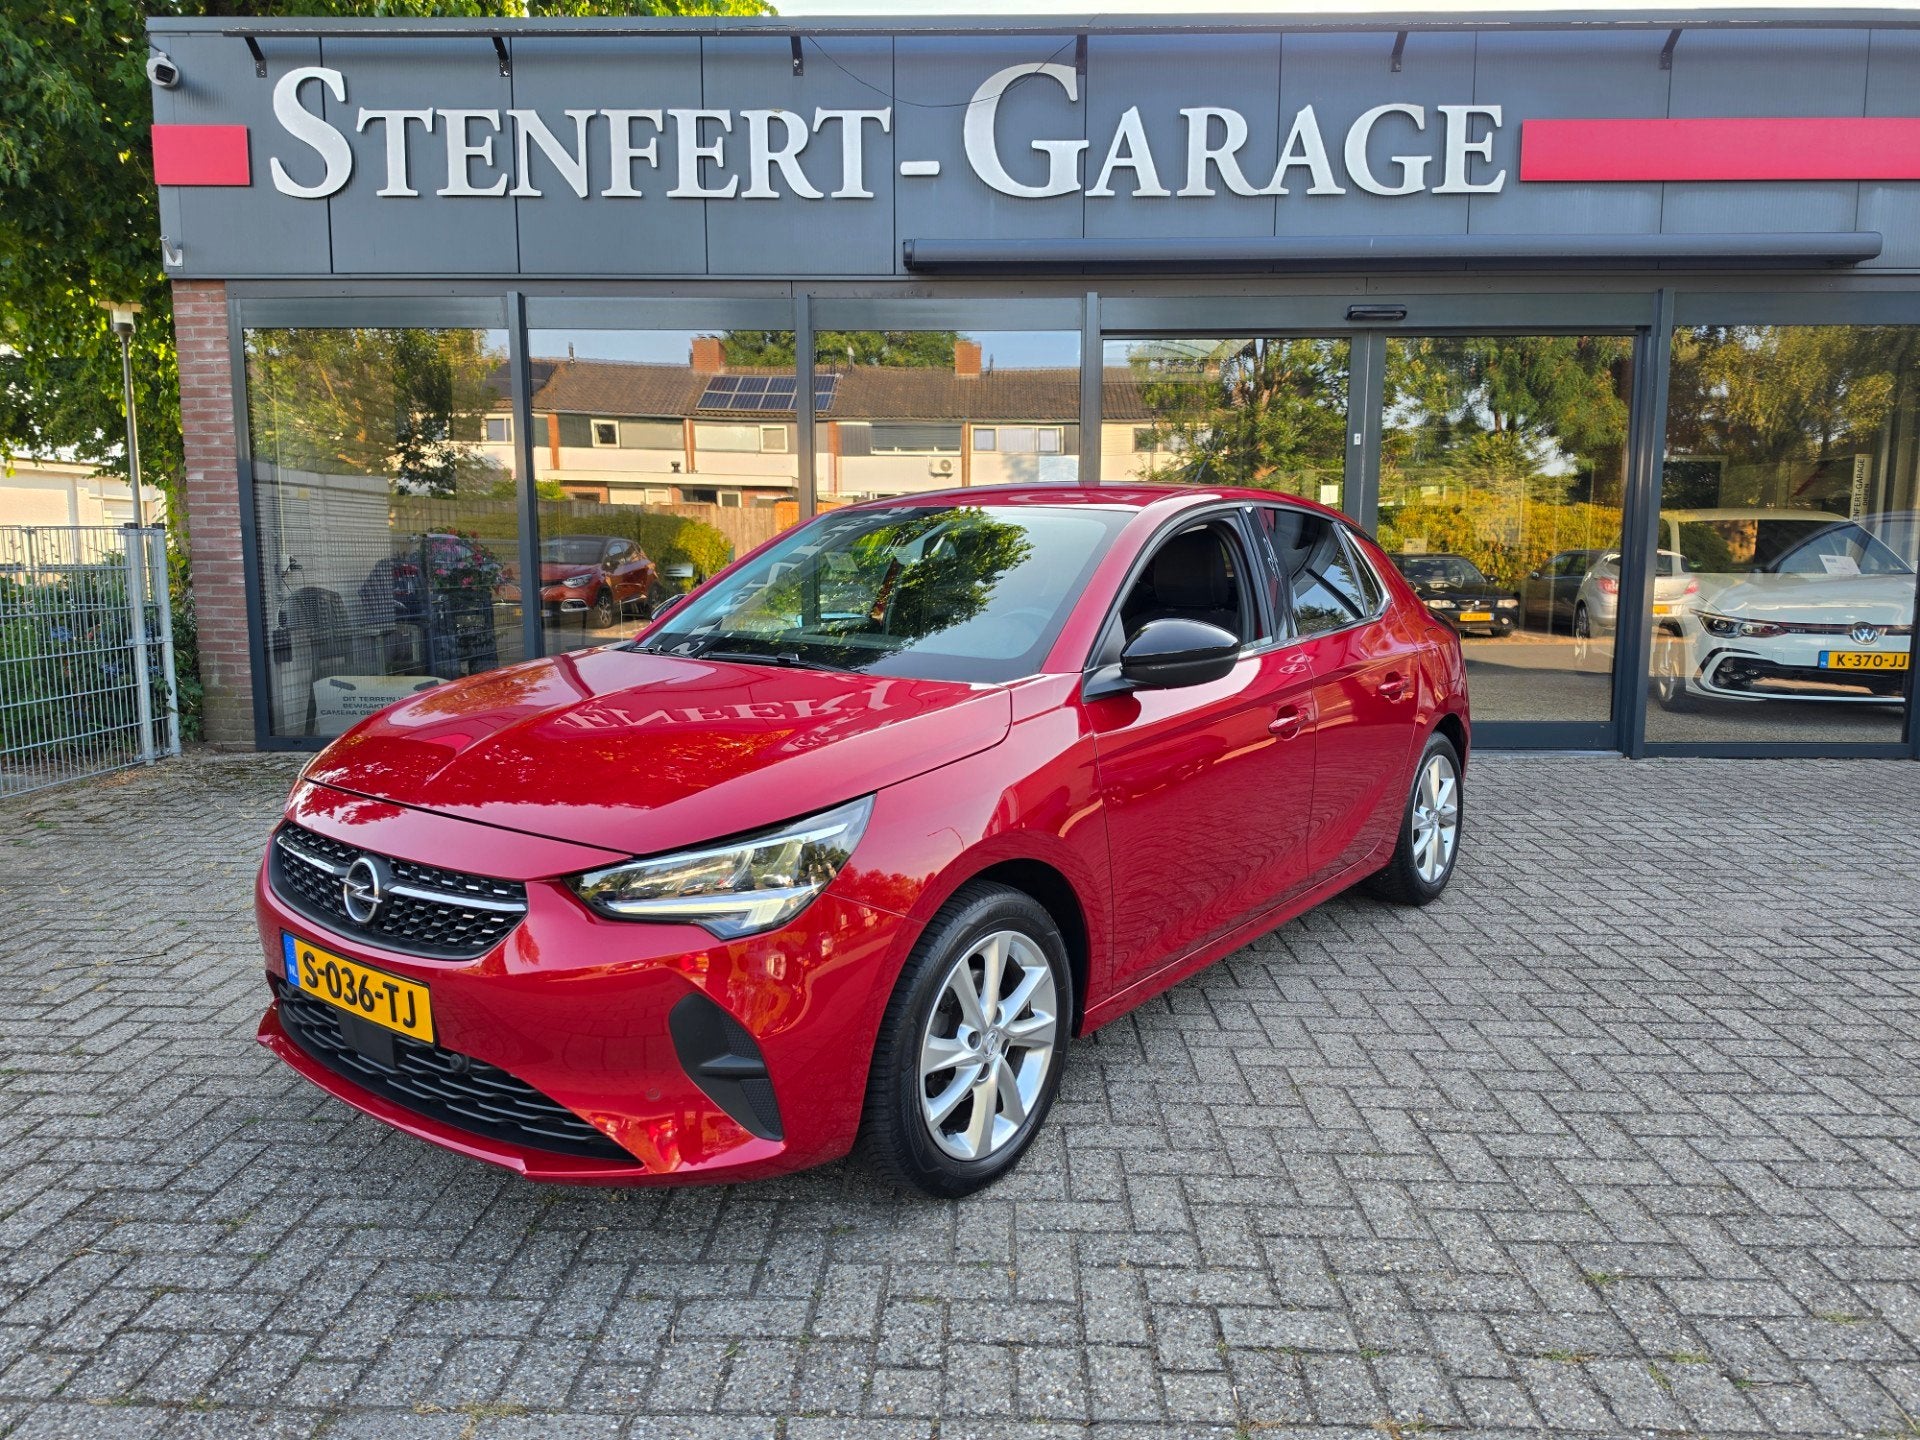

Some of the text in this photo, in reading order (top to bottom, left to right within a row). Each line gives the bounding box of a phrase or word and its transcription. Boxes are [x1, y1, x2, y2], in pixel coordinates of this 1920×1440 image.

[270, 62, 1507, 199] STENFERT-GARAGE
[1852, 458, 1865, 520] ENFERT-GARAGE
[1836, 654, 1907, 667] K-370-JJ
[302, 950, 417, 1029] S-036-TJ
